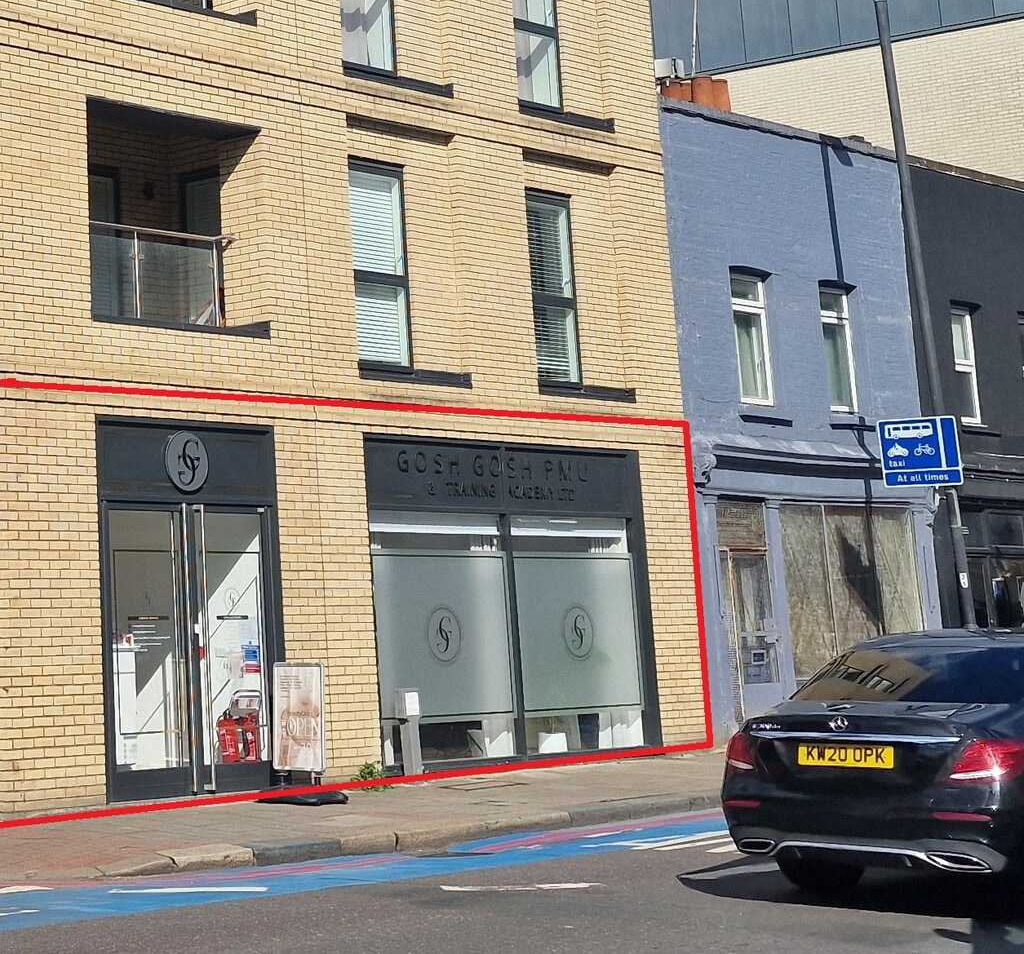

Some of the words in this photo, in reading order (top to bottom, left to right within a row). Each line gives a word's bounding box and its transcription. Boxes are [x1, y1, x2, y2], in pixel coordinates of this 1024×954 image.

[397, 449, 461, 476] GOSH
[473, 454, 533, 481] GOSH
[889, 459, 905, 468] taxi
[897, 474, 907, 483] At
[910, 474, 921, 482] all
[924, 473, 949, 481] times
[287, 717, 319, 738] OPEN
[805, 745, 847, 762] KW20
[853, 747, 885, 764] OPK
